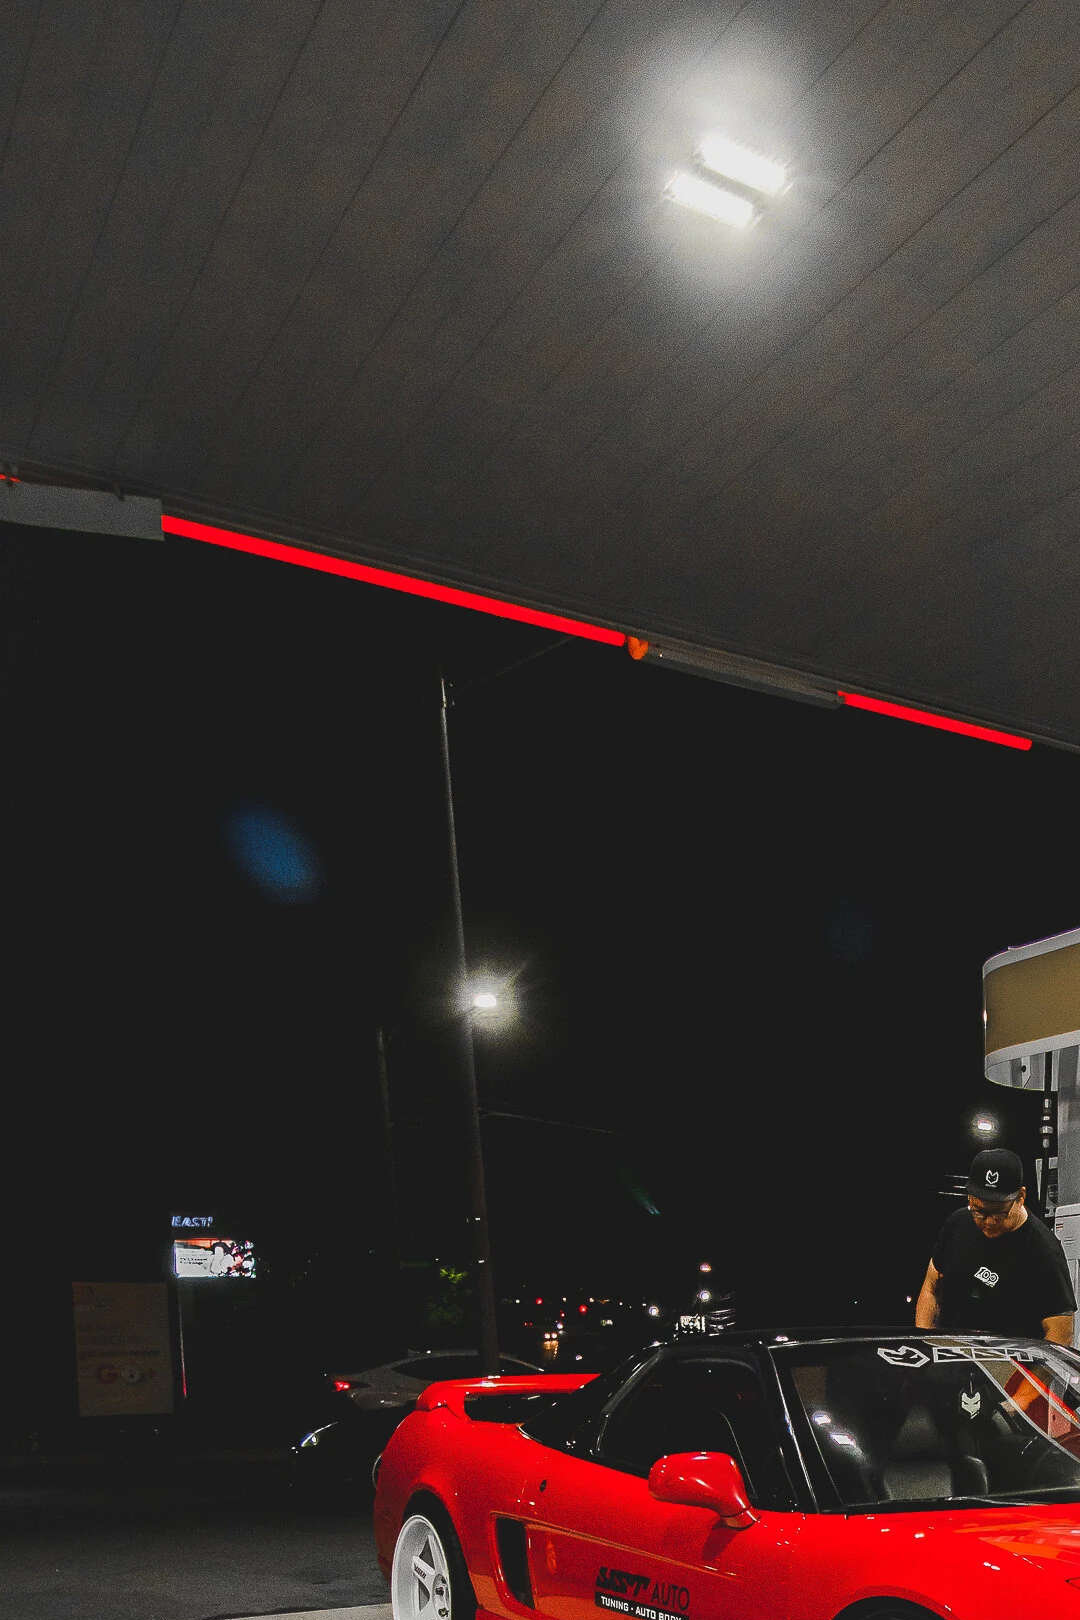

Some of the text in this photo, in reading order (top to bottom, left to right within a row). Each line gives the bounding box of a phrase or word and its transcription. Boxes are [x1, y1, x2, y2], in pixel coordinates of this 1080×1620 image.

[601, 1596, 629, 1612] TUNING
[636, 1606, 656, 1619] AUTO
[651, 1582, 690, 1611] AUTO
